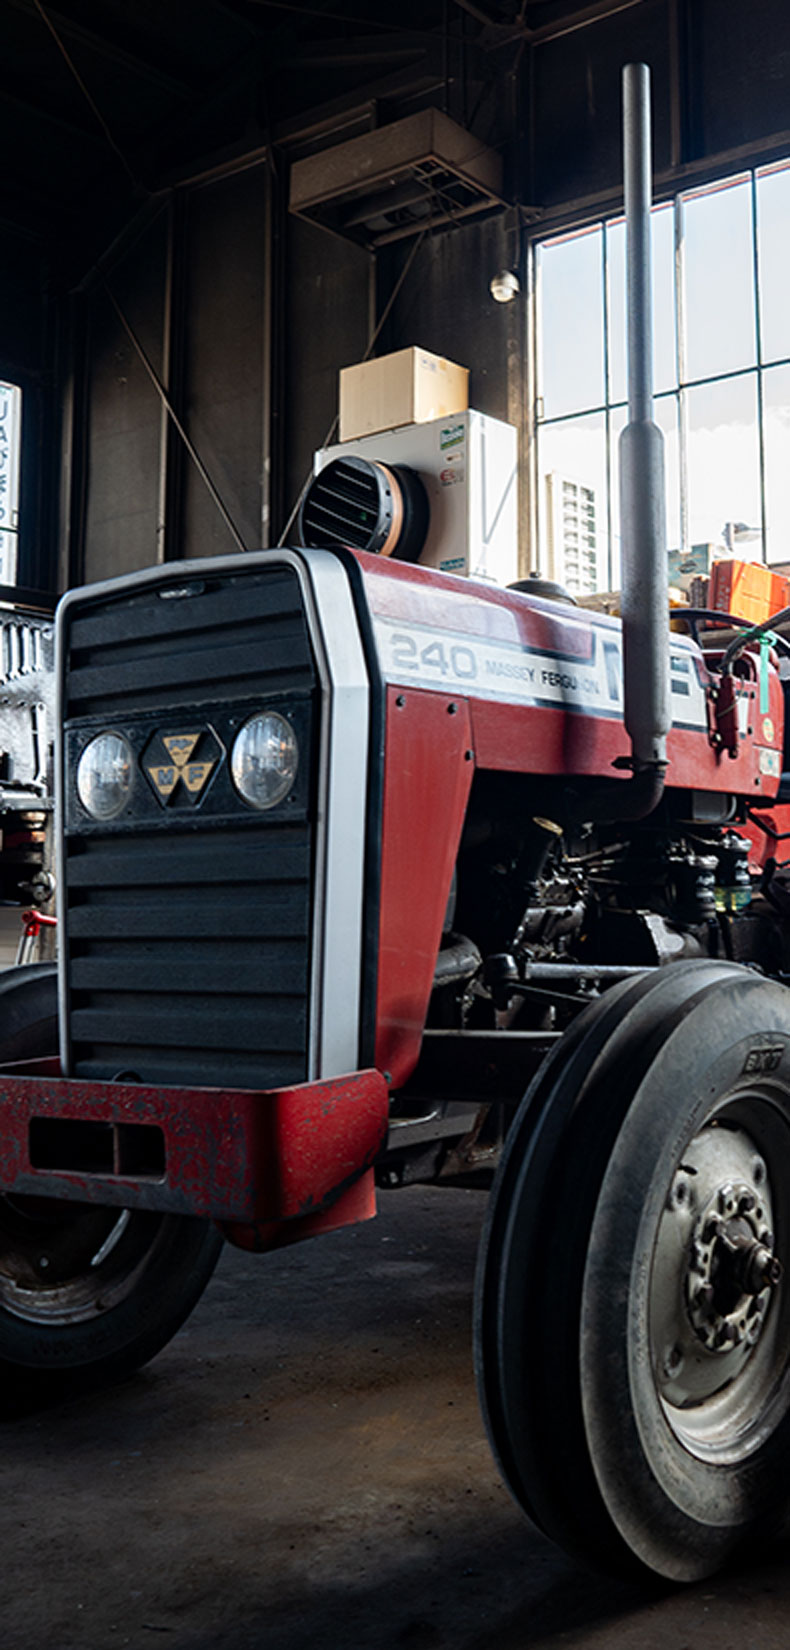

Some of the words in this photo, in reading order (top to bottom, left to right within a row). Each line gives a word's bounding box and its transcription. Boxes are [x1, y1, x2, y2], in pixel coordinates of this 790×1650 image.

[390, 634, 477, 679] 240
[486, 660, 535, 683] MASSEY
[542, 670, 599, 695] FERGUON
